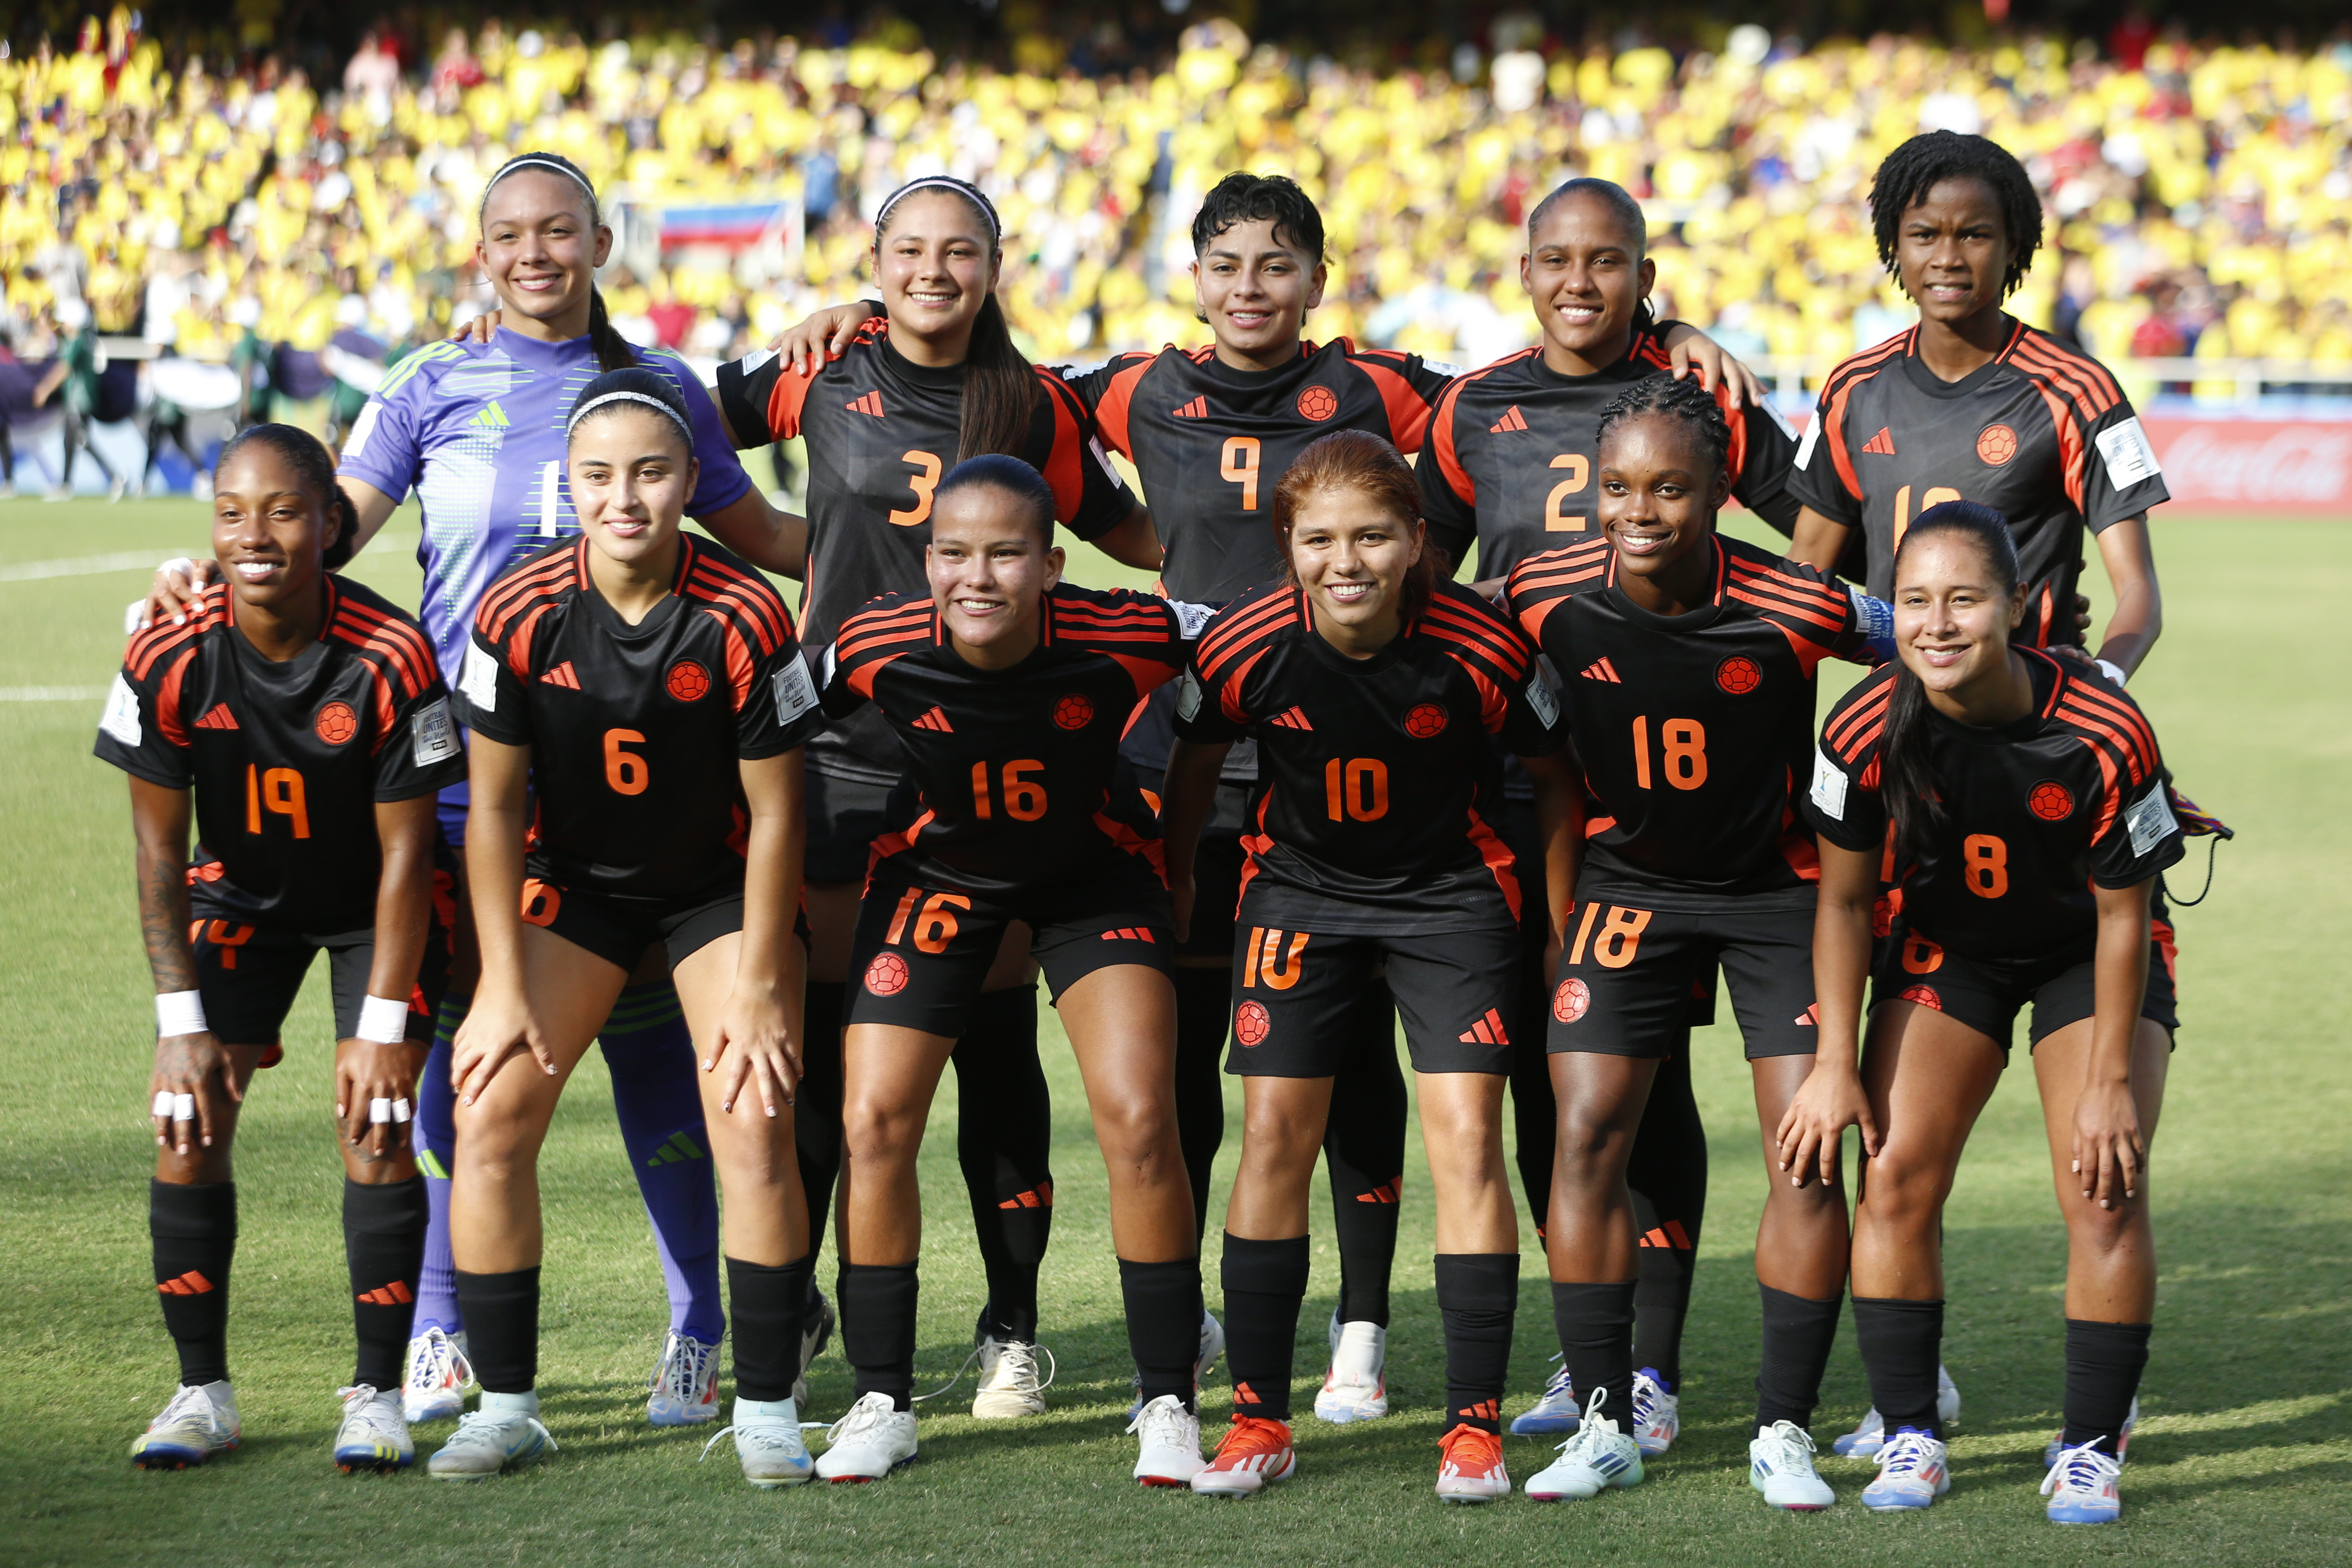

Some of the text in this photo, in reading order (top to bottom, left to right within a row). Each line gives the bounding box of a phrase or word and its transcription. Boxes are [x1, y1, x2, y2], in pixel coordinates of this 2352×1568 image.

[889, 450, 943, 527] 3
[1220, 437, 1262, 511] 9
[1545, 454, 1590, 532] 2
[1894, 485, 1961, 560] 1
[783, 665, 802, 684] FOOTBALL
[784, 693, 794, 703] the
[785, 672, 803, 693] UNITES
[794, 697, 804, 707] FIFA
[423, 717, 448, 734] UNITES
[1632, 715, 1708, 790] 18
[604, 728, 649, 795] 6
[972, 759, 1048, 822] 16
[1325, 758, 1389, 822] 10
[246, 763, 311, 839] 19
[1963, 833, 2008, 899] 8
[885, 886, 971, 954] 16
[1568, 902, 1652, 969] 18
[1243, 926, 1310, 990] 10
